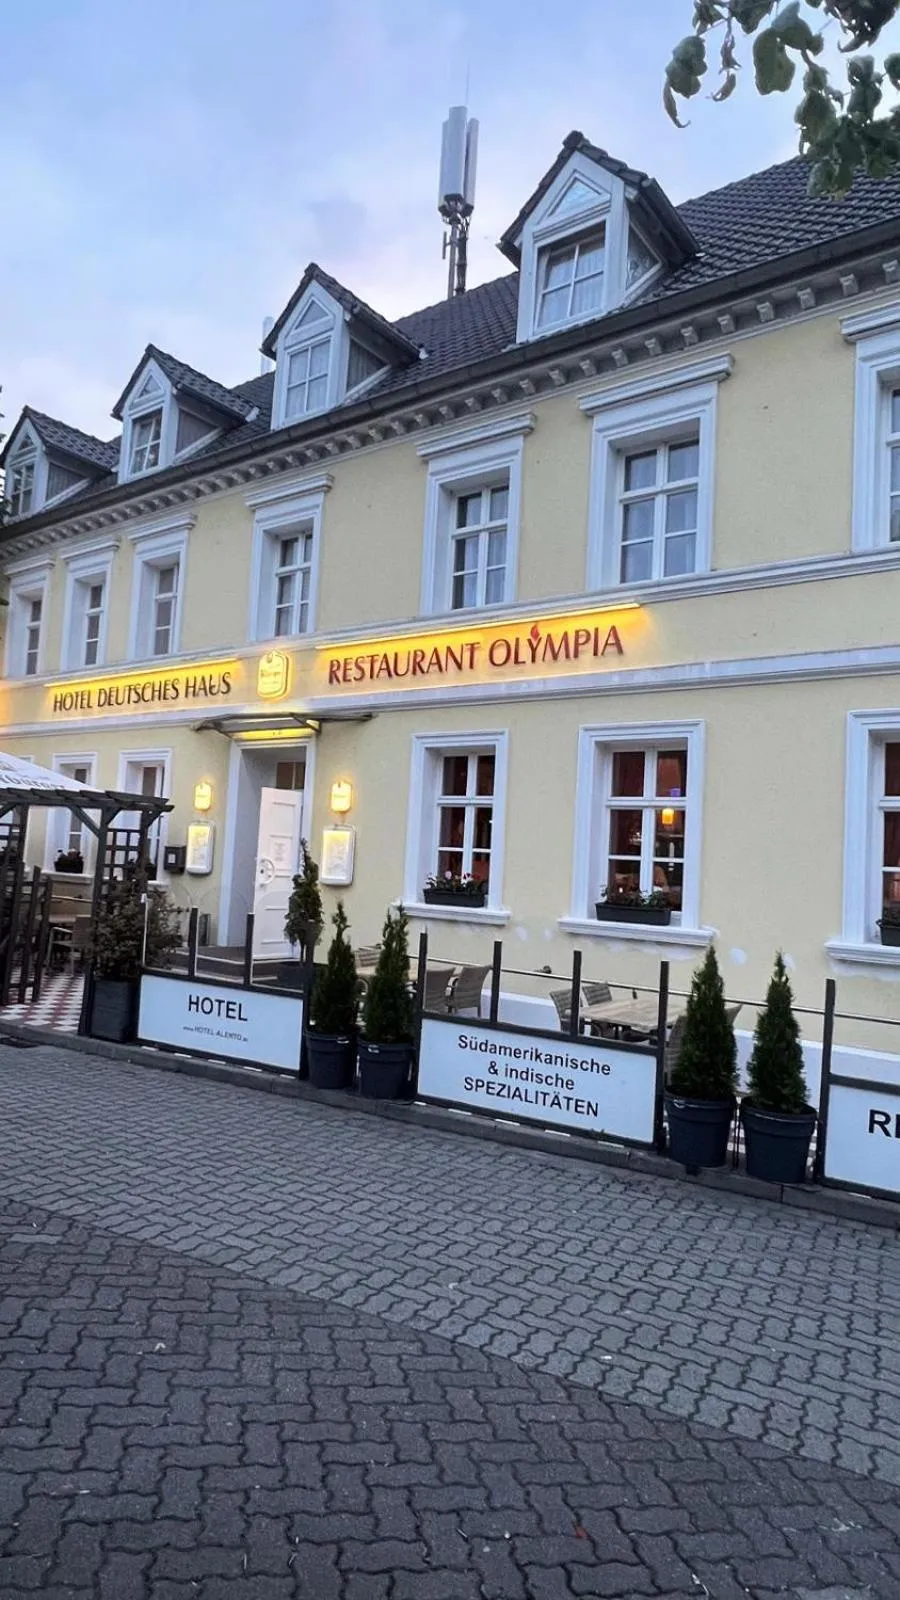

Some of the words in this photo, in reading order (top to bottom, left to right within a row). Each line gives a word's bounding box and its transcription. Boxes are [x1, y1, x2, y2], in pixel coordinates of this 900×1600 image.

[328, 641, 481, 686] RESTAURANT
[488, 624, 625, 668] OLYMPIA
[53, 688, 92, 712] HOTEL
[97, 678, 180, 708] DEUTSCHES
[184, 671, 232, 699] HAUS
[188, 994, 248, 1022] HOTEL
[458, 1034, 612, 1076] Südamerikanische
[487, 1060, 499, 1076] &
[504, 1063, 576, 1091] indische
[463, 1076, 600, 1118] SPEZIALITÄTEN
